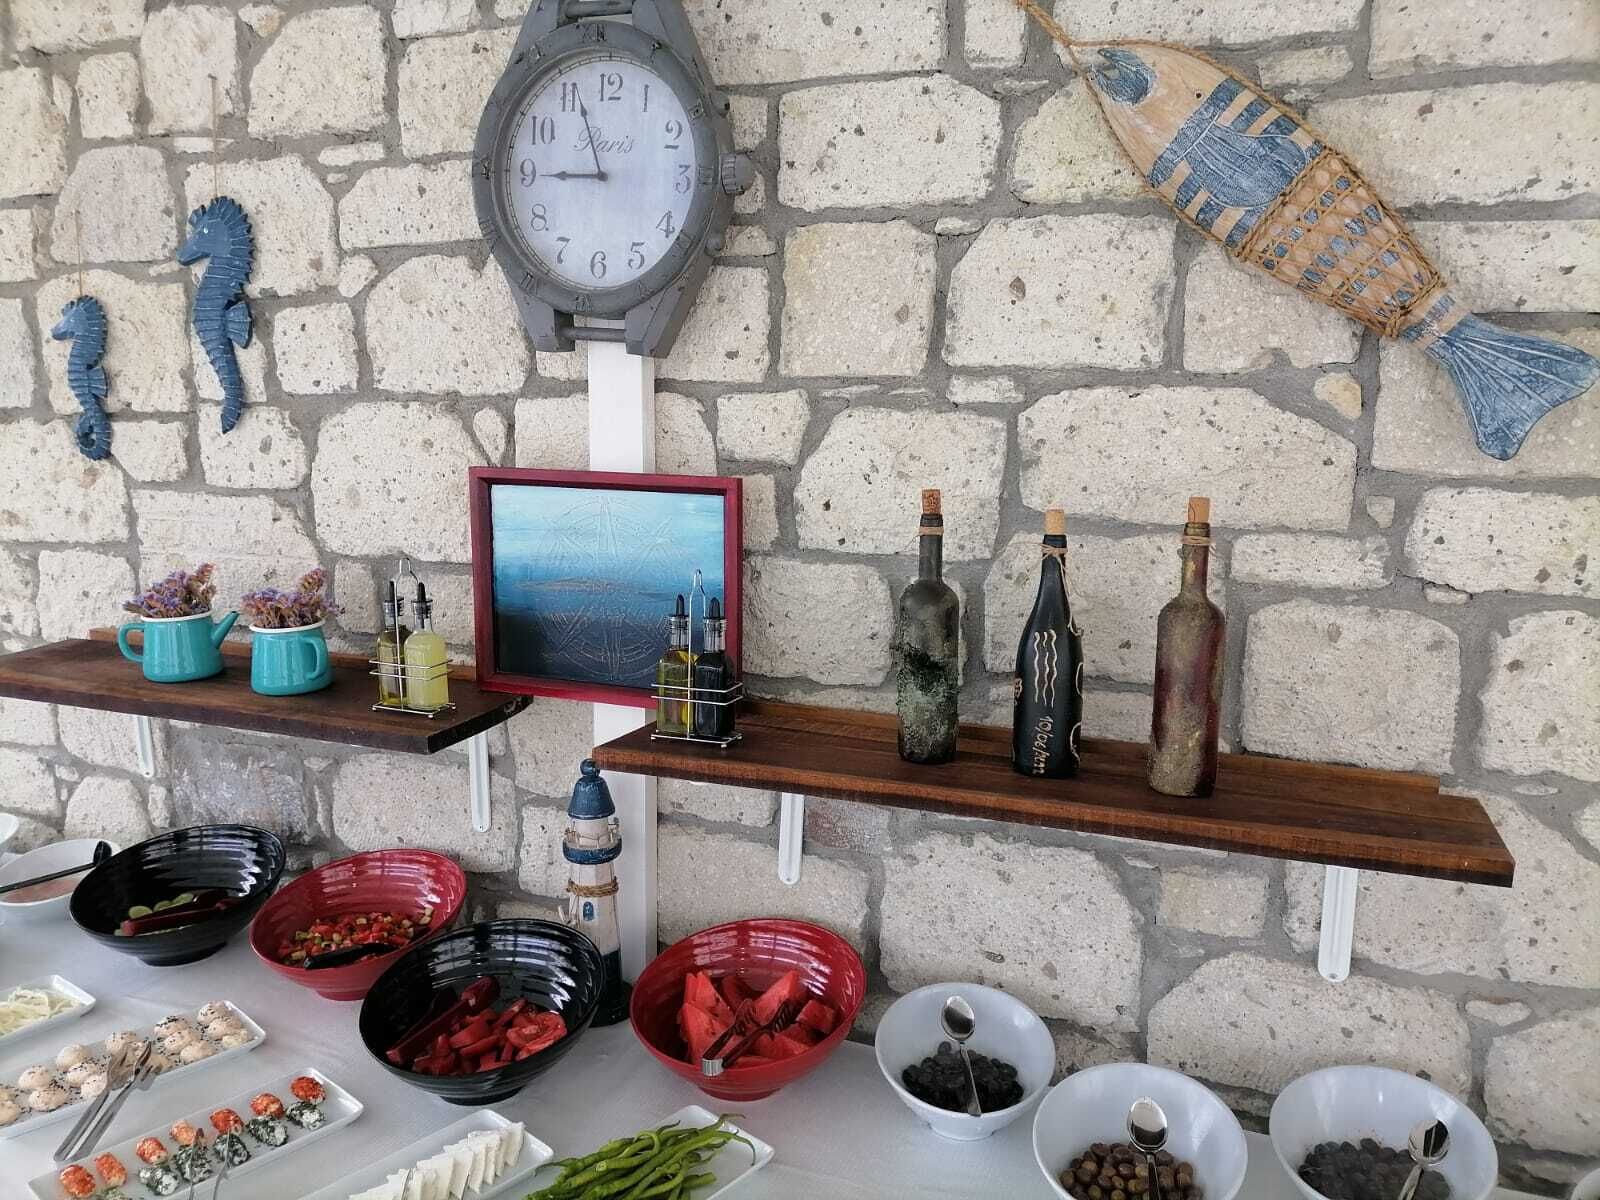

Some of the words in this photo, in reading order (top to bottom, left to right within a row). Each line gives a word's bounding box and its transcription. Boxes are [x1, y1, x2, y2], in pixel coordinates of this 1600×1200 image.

[561, 82, 577, 112] 11
[599, 72, 623, 101] 12
[643, 84, 649, 112] 1
[531, 116, 556, 145] 10
[573, 126, 635, 154] Paris
[664, 119, 683, 150] 2
[519, 158, 537, 187] 9
[675, 163, 692, 194] 3
[655, 211, 676, 238] 4
[555, 237, 572, 264] 7
[627, 242, 646, 270] 5
[590, 251, 607, 279] 6
